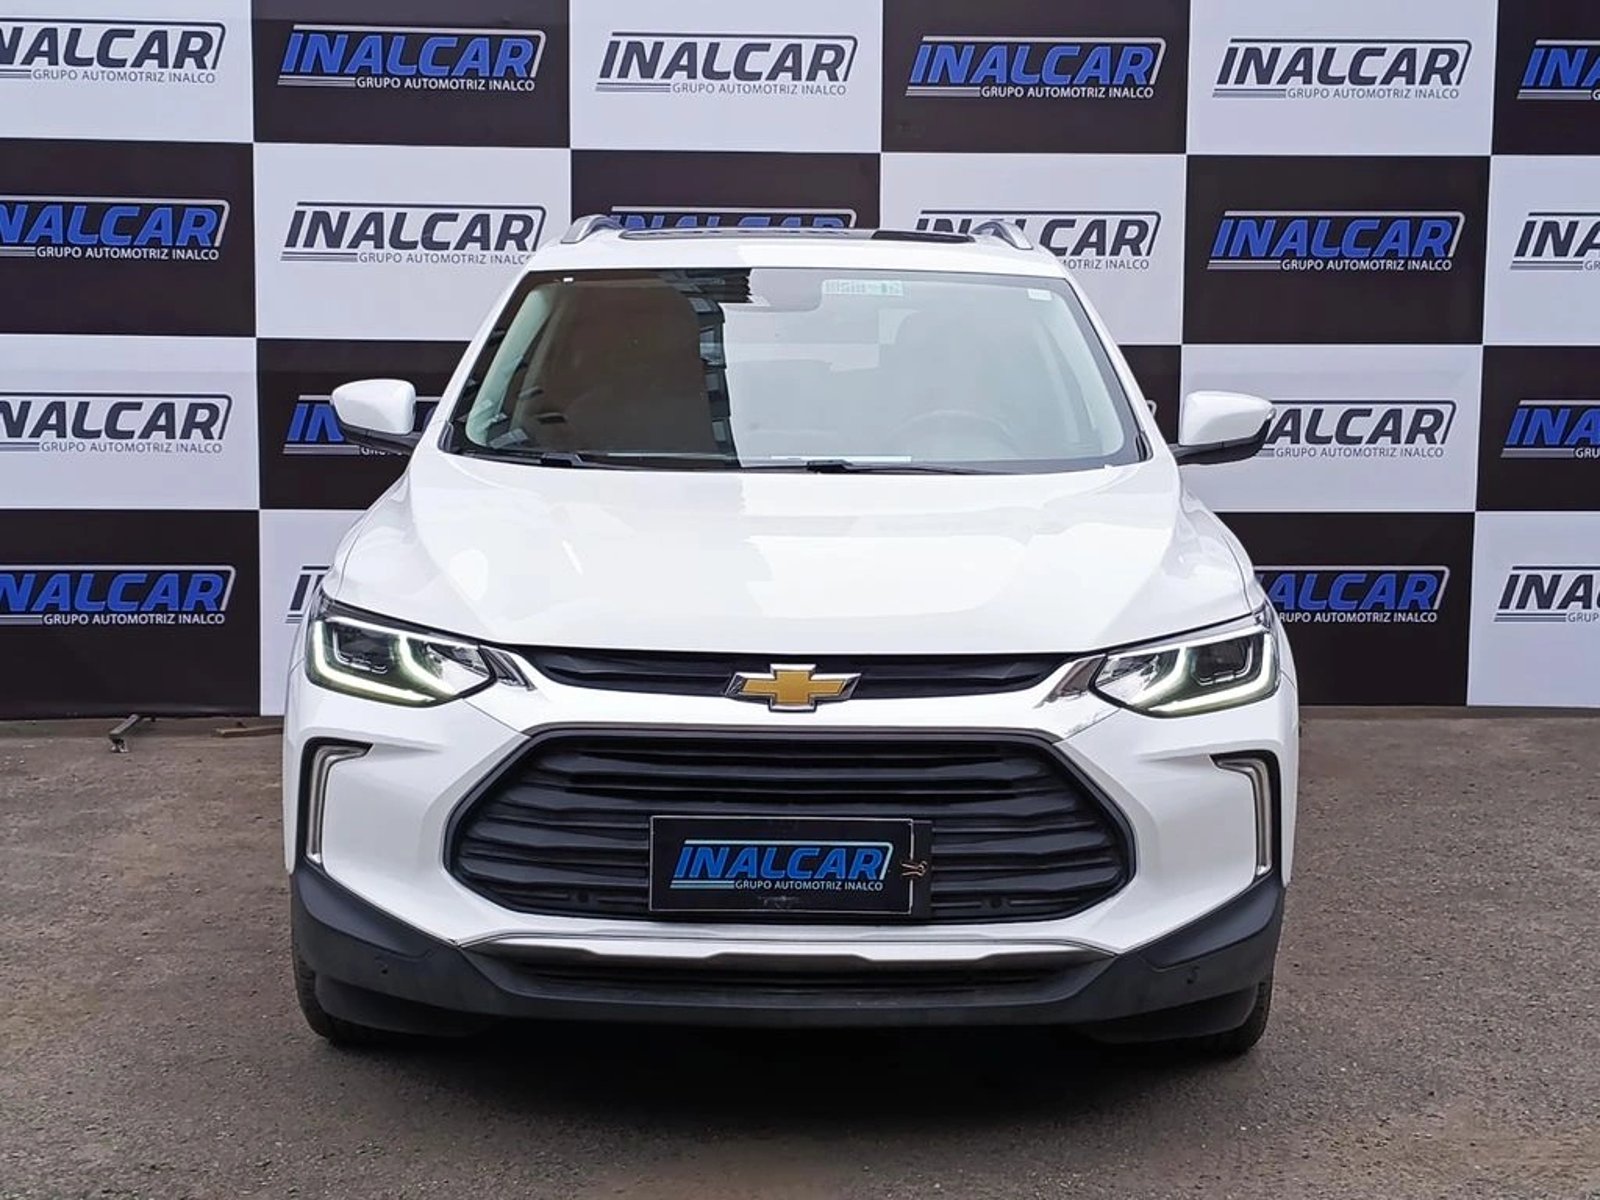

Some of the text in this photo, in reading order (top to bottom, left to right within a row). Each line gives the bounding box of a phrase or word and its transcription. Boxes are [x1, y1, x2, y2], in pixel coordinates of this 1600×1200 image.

[281, 33, 534, 77] INALCAR
[599, 41, 846, 82] INALCAR
[910, 45, 1154, 85] INALCAR
[1217, 47, 1460, 85] INALCAR
[33, 69, 215, 83] GRUPO AUTOMOTRIZ INALCO
[357, 77, 535, 91] GRUPO AUTOMOTRIZ INALCO
[672, 83, 846, 96] GRUPO AUTOMOTRIZ INALCO
[981, 86, 1154, 98] GRUPO AUTOMOTRIZ INALCO
[1287, 88, 1459, 99] GRUPO AUTOMOTRIZ INALCO
[284, 211, 534, 251] INALCAR
[1211, 220, 1452, 258] INALCAR
[37, 247, 219, 260] GRUPO AUTOMOTRIZ INALCO
[359, 253, 402, 263] GRUPO
[406, 253, 487, 265] AUTOMOTRIZ
[1106, 259, 1149, 269] INALCO
[1282, 259, 1452, 271] GRUPO AUTOMOTRIZ INALCO
[1266, 408, 1445, 445] ALCAR
[41, 442, 222, 453] GRUPO AUTOMOTRIZ INALCO
[1276, 447, 1444, 458] GRUPO AUTOMOTRIZ INALCO
[0, 573, 223, 612] NALCAR
[1258, 574, 1438, 610] ALCAR
[1498, 574, 1600, 610] INA
[43, 614, 225, 625] GRUPO AUTOMOTRIZ INALCO
[1279, 612, 1437, 622] RUPO AUTOMOTRIZ INALCO
[673, 846, 882, 880] INALCAR
[735, 881, 883, 891] GRUPO AUTOMOTRIZ INALCO
